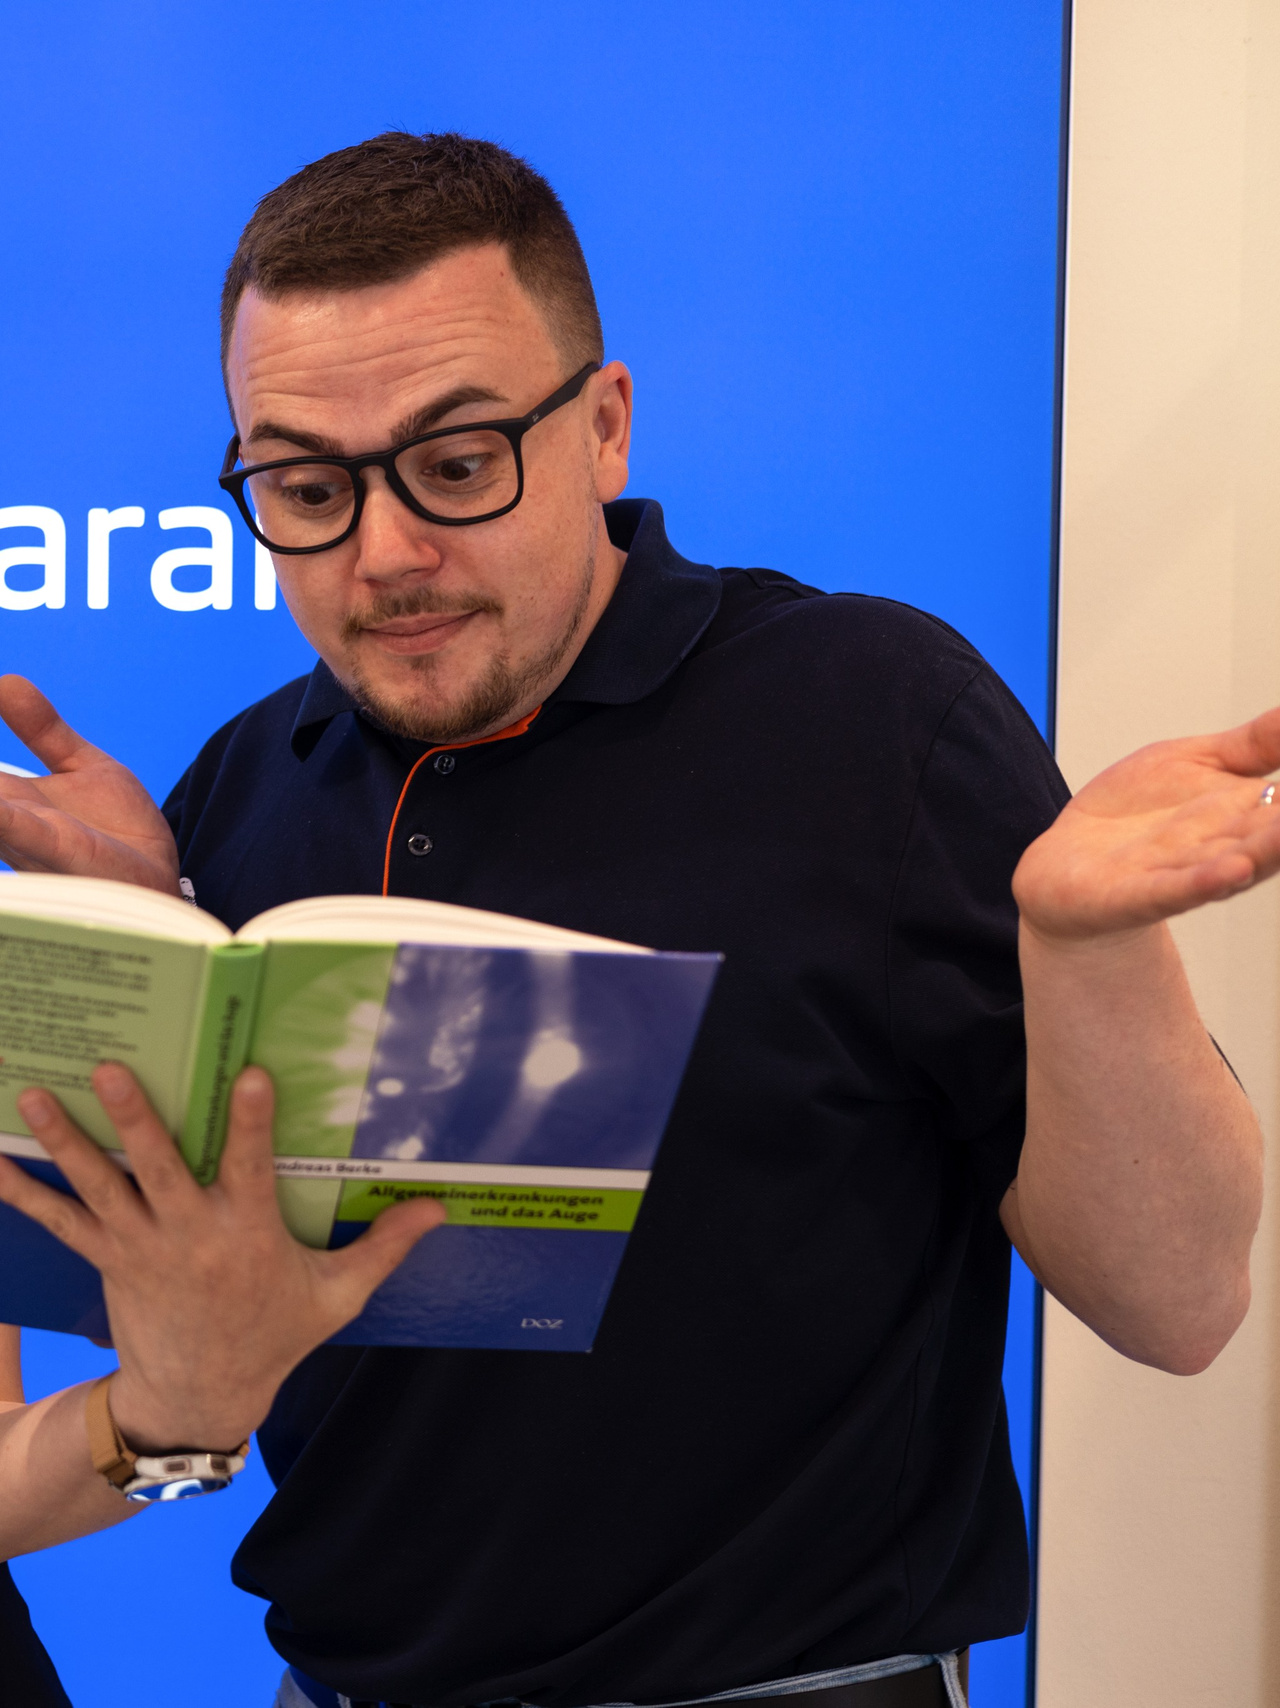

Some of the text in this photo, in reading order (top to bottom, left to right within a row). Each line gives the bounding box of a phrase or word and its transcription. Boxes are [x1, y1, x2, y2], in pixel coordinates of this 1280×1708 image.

[275, 1160, 332, 1173] ndreas
[470, 1206, 600, 1223] und das Auge
[521, 1317, 564, 1329] DOZ
